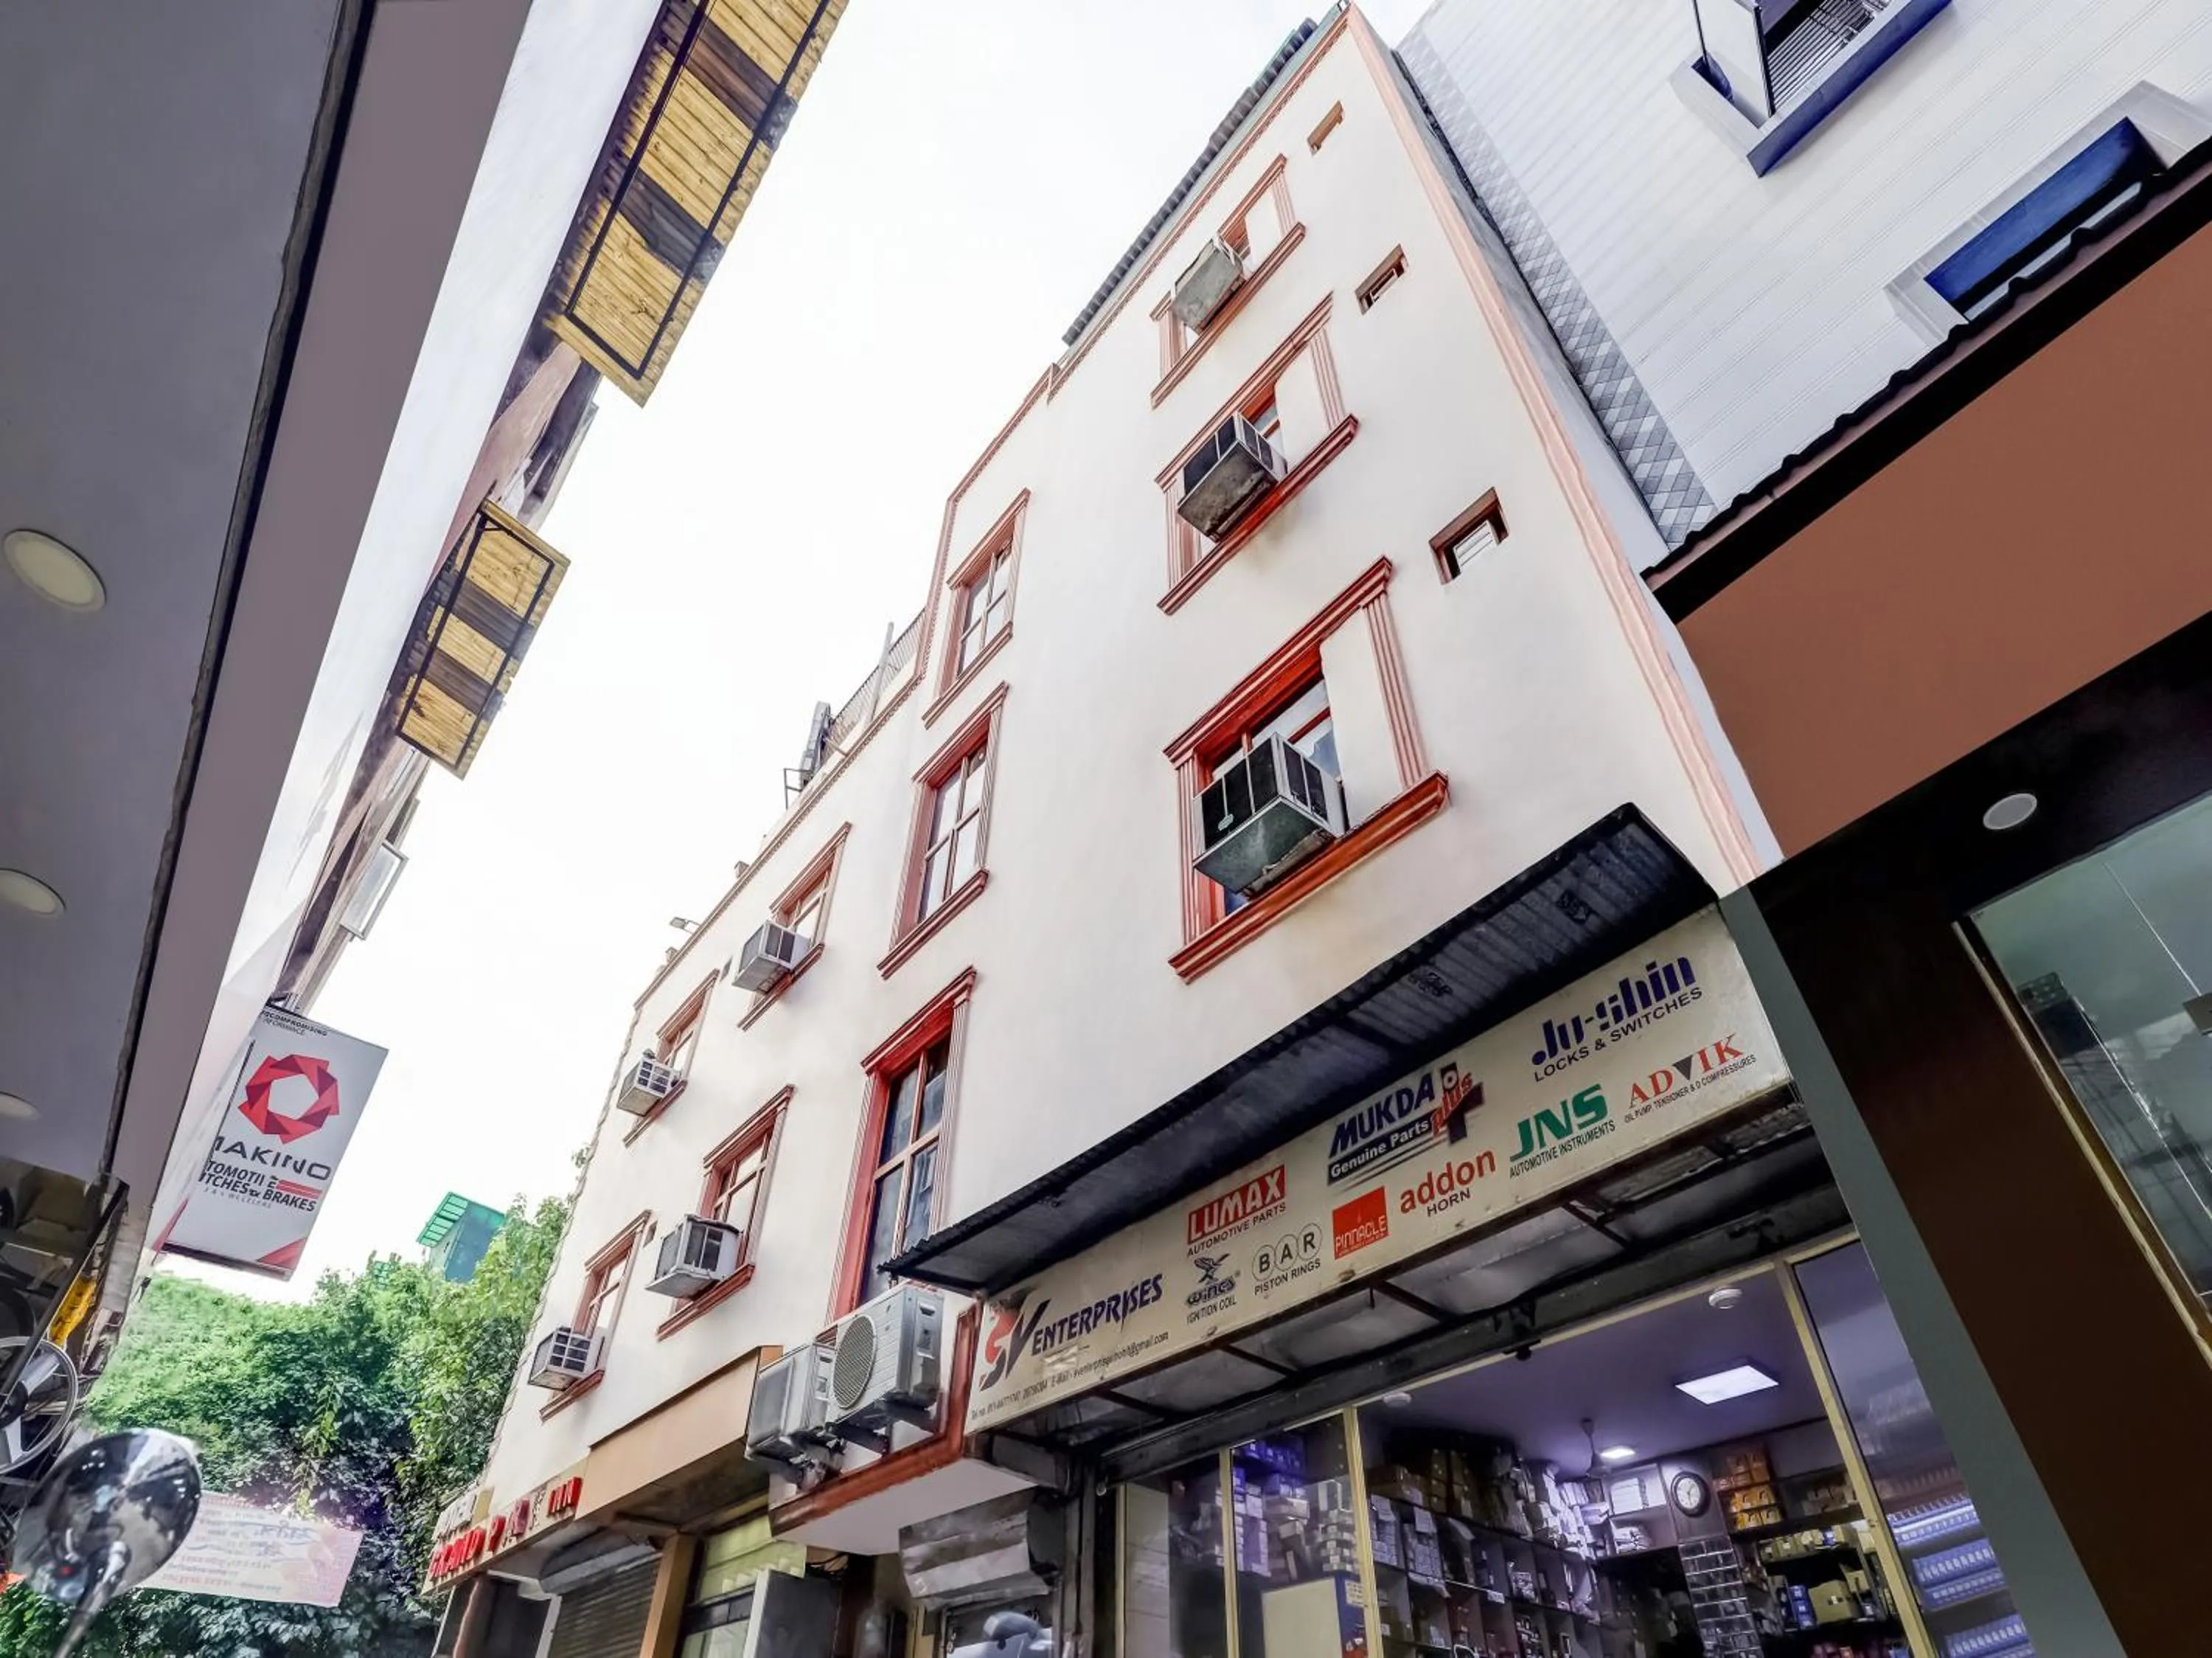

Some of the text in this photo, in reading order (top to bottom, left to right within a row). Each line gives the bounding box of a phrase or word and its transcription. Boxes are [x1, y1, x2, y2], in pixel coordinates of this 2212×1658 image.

[1534, 987, 1704, 1083] LOCKS & SWITCHES
[1628, 1034, 1744, 1109] ADVIK
[1328, 1072, 1436, 1159] MUKDA
[1510, 1083, 1609, 1162] JNS
[1331, 1119, 1430, 1178] Genuine Parts
[1510, 1119, 1616, 1179] AUTOMOTIVE INSTRUMENTS
[262, 1188, 318, 1213] BRAKES
[1188, 1166, 1284, 1244] LUMAX
[1400, 1150, 1497, 1214] addon
[1427, 1188, 1472, 1217] HORN
[1186, 1201, 1287, 1258] AUTOMOTIVE PARTS
[1254, 1258, 1321, 1296] PISTON RINGS
[1032, 1273, 1164, 1357] ENTERPRISES
